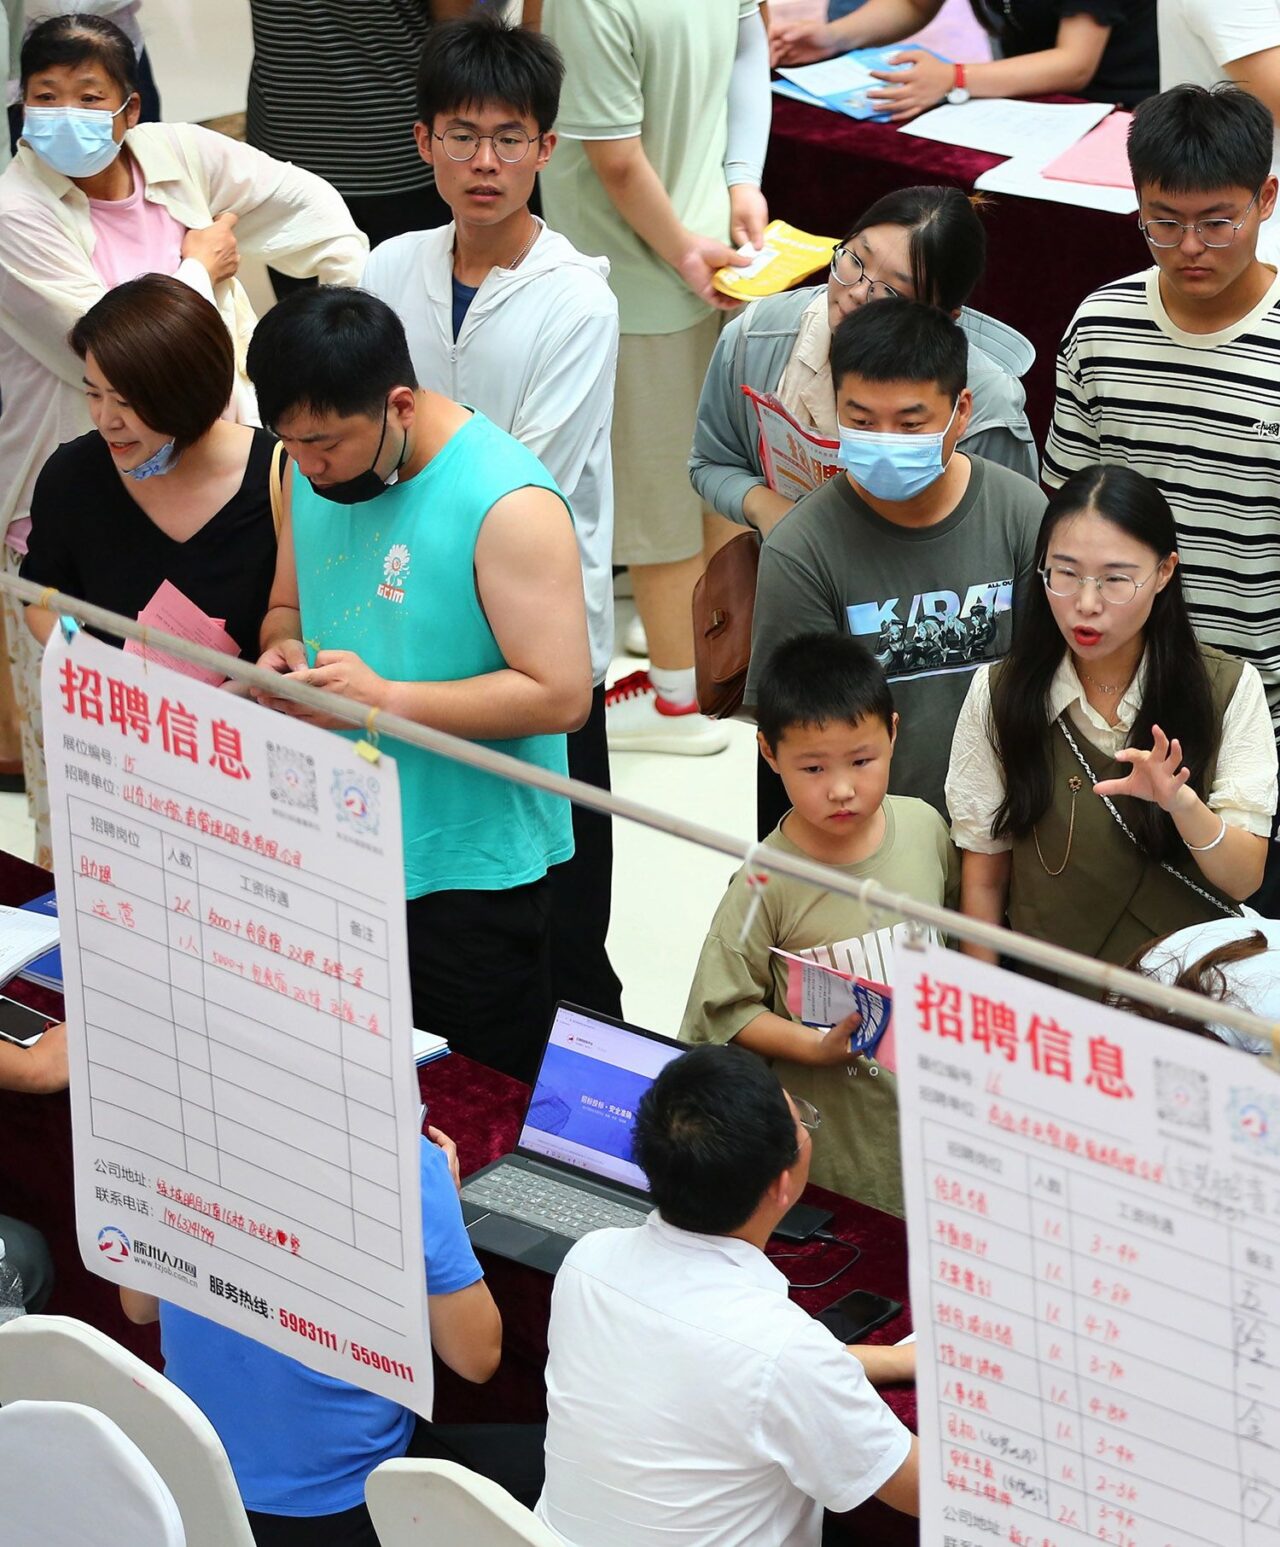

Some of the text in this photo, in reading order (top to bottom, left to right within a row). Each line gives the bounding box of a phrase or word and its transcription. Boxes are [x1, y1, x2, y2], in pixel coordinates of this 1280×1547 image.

[59, 657, 251, 781] 招聘信息
[62, 734, 118, 766] 展位编号：
[65, 764, 121, 797] 招聘单位：
[91, 816, 141, 848] 招聘岗位
[168, 848, 193, 870] 人数
[240, 875, 290, 909] 工资待遇
[914, 972, 1135, 1099] 招聘信息
[93, 1157, 152, 1188] 公司地址：
[95, 1186, 155, 1217] 联系电话：
[209, 1274, 277, 1321] 服务热线：
[279, 1307, 339, 1352] 5983111
[350, 1341, 415, 1384] 5590111
